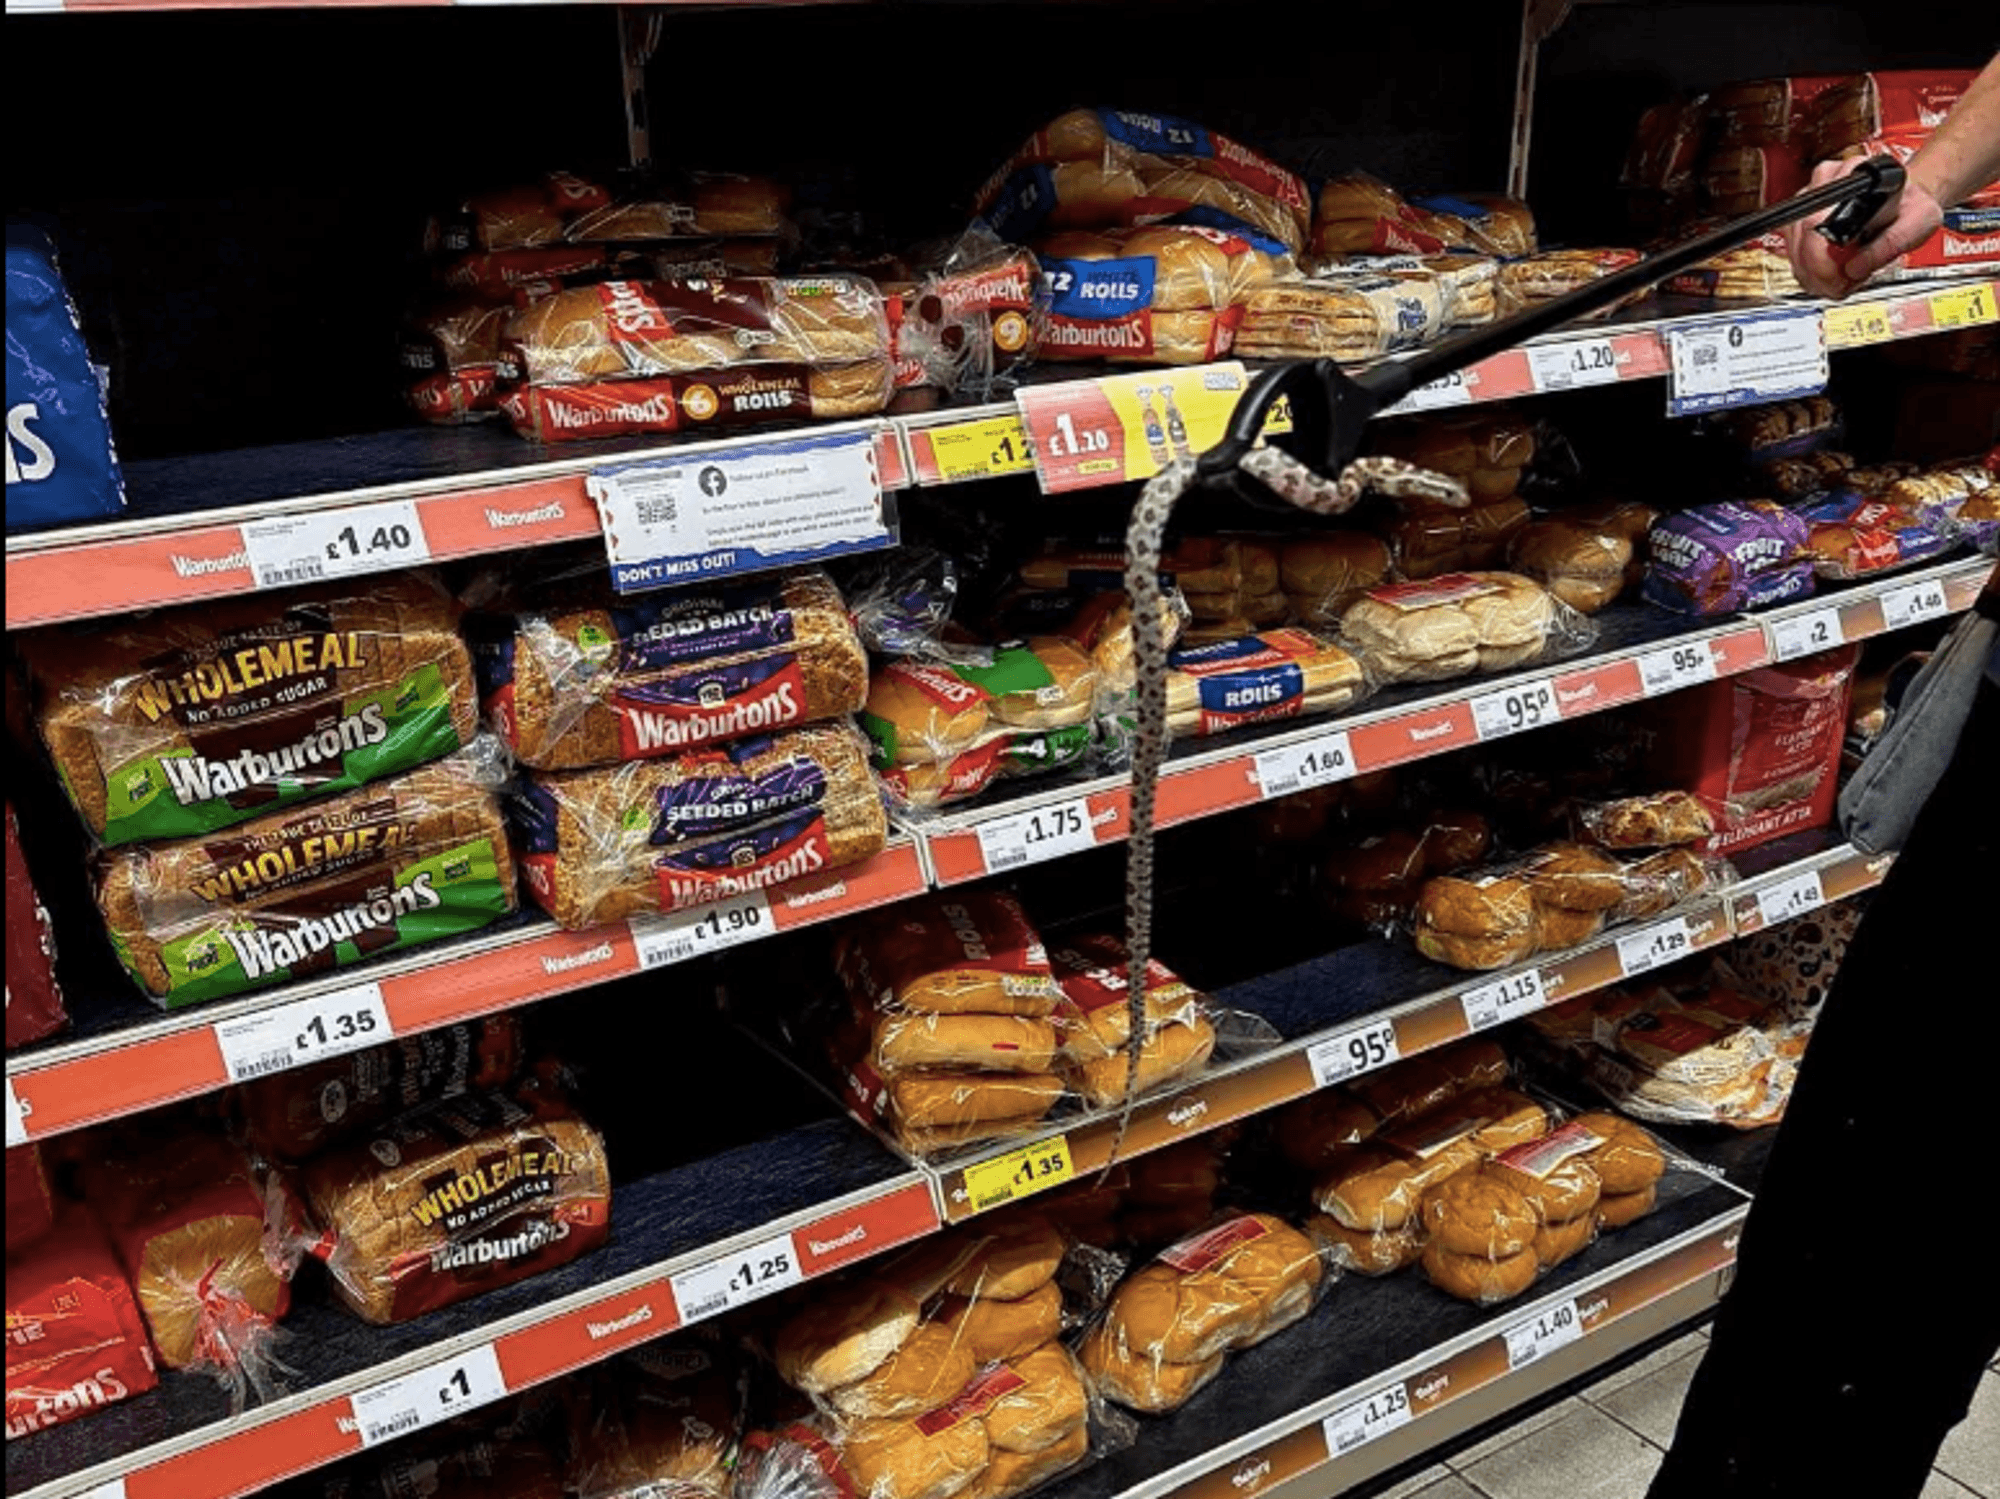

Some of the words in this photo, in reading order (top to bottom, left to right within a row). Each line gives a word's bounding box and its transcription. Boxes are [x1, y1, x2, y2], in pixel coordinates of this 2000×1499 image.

[1080, 280, 1139, 300] ROLLS
[1571, 346, 1614, 372] £1.20
[545, 392, 670, 429] Warburtons
[734, 390, 792, 412] ROLLS
[1050, 413, 1110, 456] £1.20
[325, 524, 411, 559] £1.40
[617, 565, 663, 583] DON'T
[666, 558, 700, 576] MISS
[701, 551, 736, 570] OUT!
[1811, 621, 1829, 643] £2
[135, 632, 367, 723] WHOLEMEAL
[1225, 683, 1283, 707] ROLLS
[186, 709, 211, 723] NO
[275, 676, 328, 703] SUGAR
[628, 681, 798, 751] Warburtons
[160, 701, 388, 806] Warburtons
[667, 801, 749, 821] SEEDED
[1026, 806, 1082, 844] £1.75
[669, 837, 824, 908] Warburtons
[222, 872, 441, 979] Warburtons
[694, 906, 760, 940] £1.90
[1496, 975, 1537, 1007] £1.15
[295, 1008, 376, 1050] £1.35
[1167, 1099, 1208, 1126] Bakery
[1013, 1154, 1064, 1186] £1.35
[411, 1152, 576, 1227] WHOLEMEAL
[446, 1214, 467, 1229] NO
[431, 1219, 571, 1273] Warburtons
[729, 1254, 790, 1292] £1.25
[1533, 1309, 1573, 1342] £1.40
[438, 1366, 471, 1405] £1
[1362, 1390, 1407, 1426] £1.25
